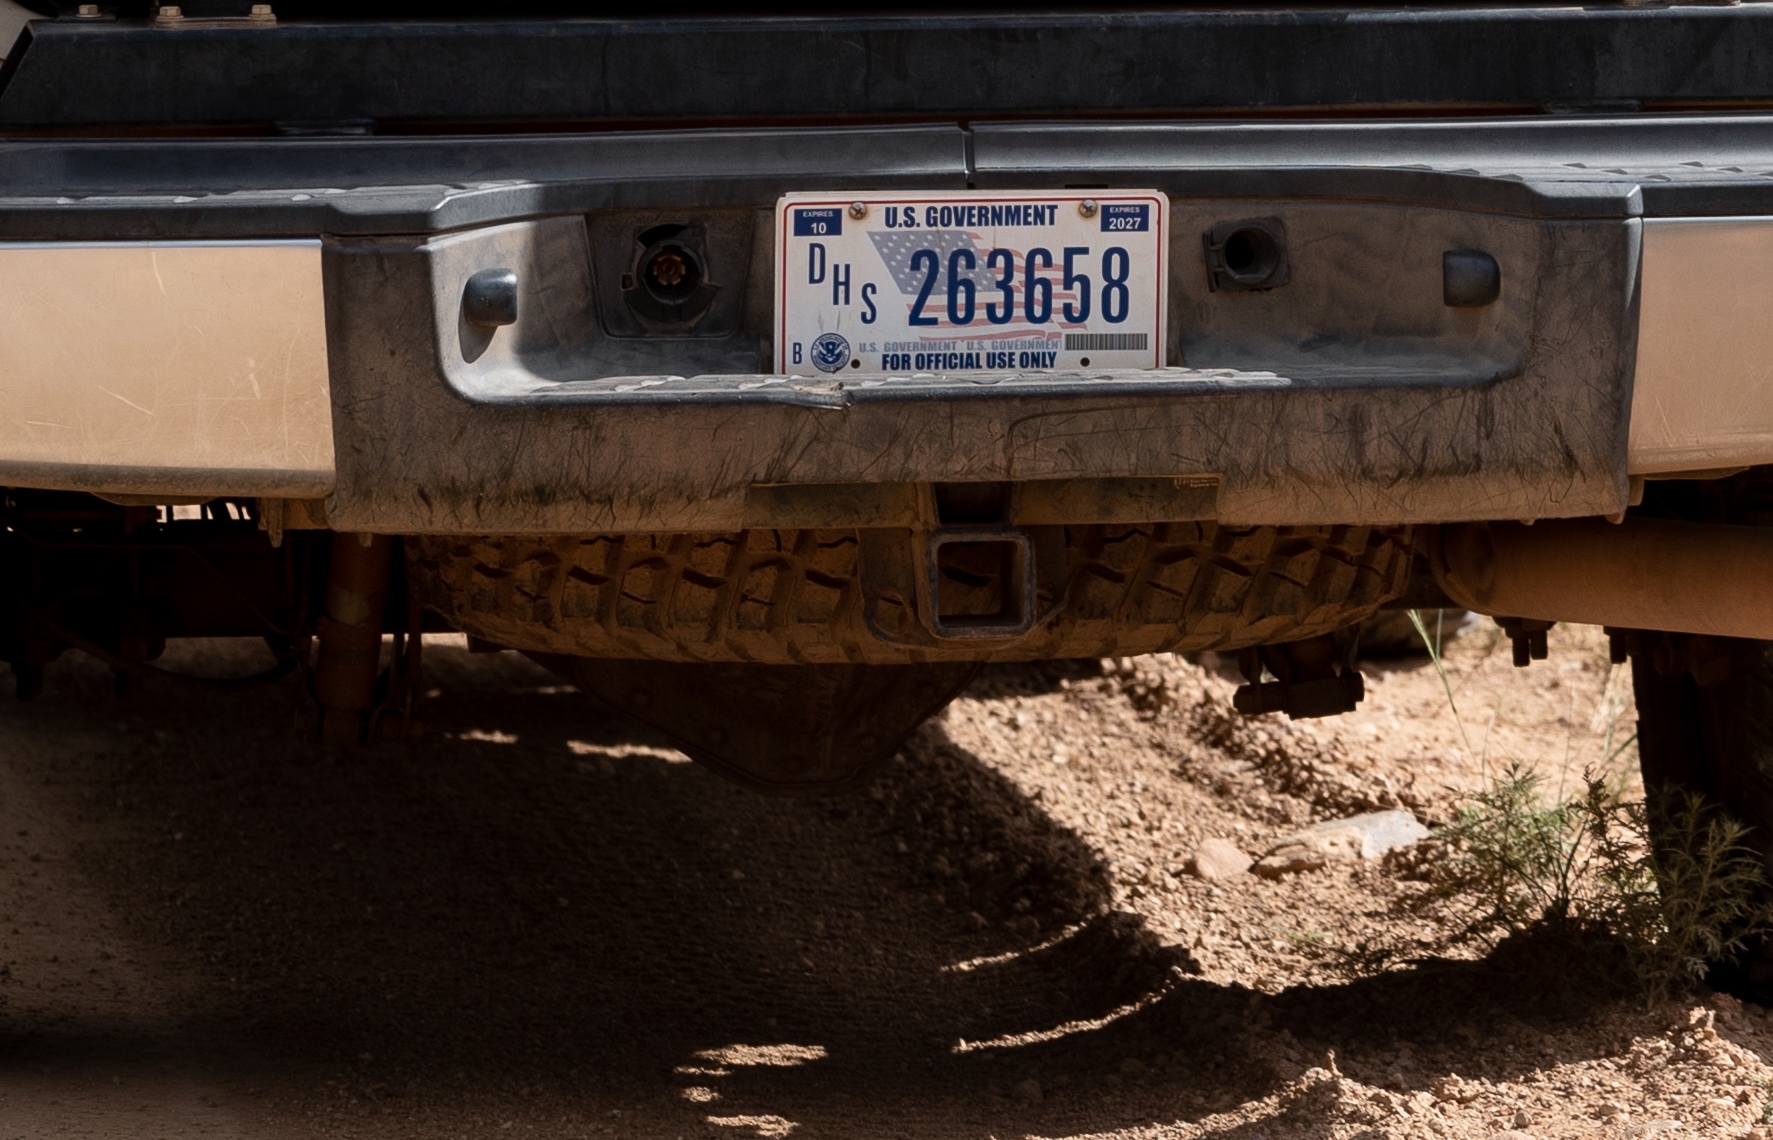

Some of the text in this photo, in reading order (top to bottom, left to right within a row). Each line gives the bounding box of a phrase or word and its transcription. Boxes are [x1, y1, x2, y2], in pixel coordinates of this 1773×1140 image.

[803, 210, 834, 218] EXPIRES
[884, 205, 1059, 229] U.S. GOVERNMENT
[1109, 206, 1141, 214] EXPIRES
[810, 222, 828, 234] 10
[1108, 217, 1142, 230] 2027
[908, 246, 1130, 327] 263658
[792, 342, 803, 365] B
[858, 341, 880, 354] U.S.
[883, 340, 958, 354] GOVERNMENT
[966, 340, 988, 352] U.S.
[881, 351, 1058, 371] FOR OFFICIAL USE ONLY
